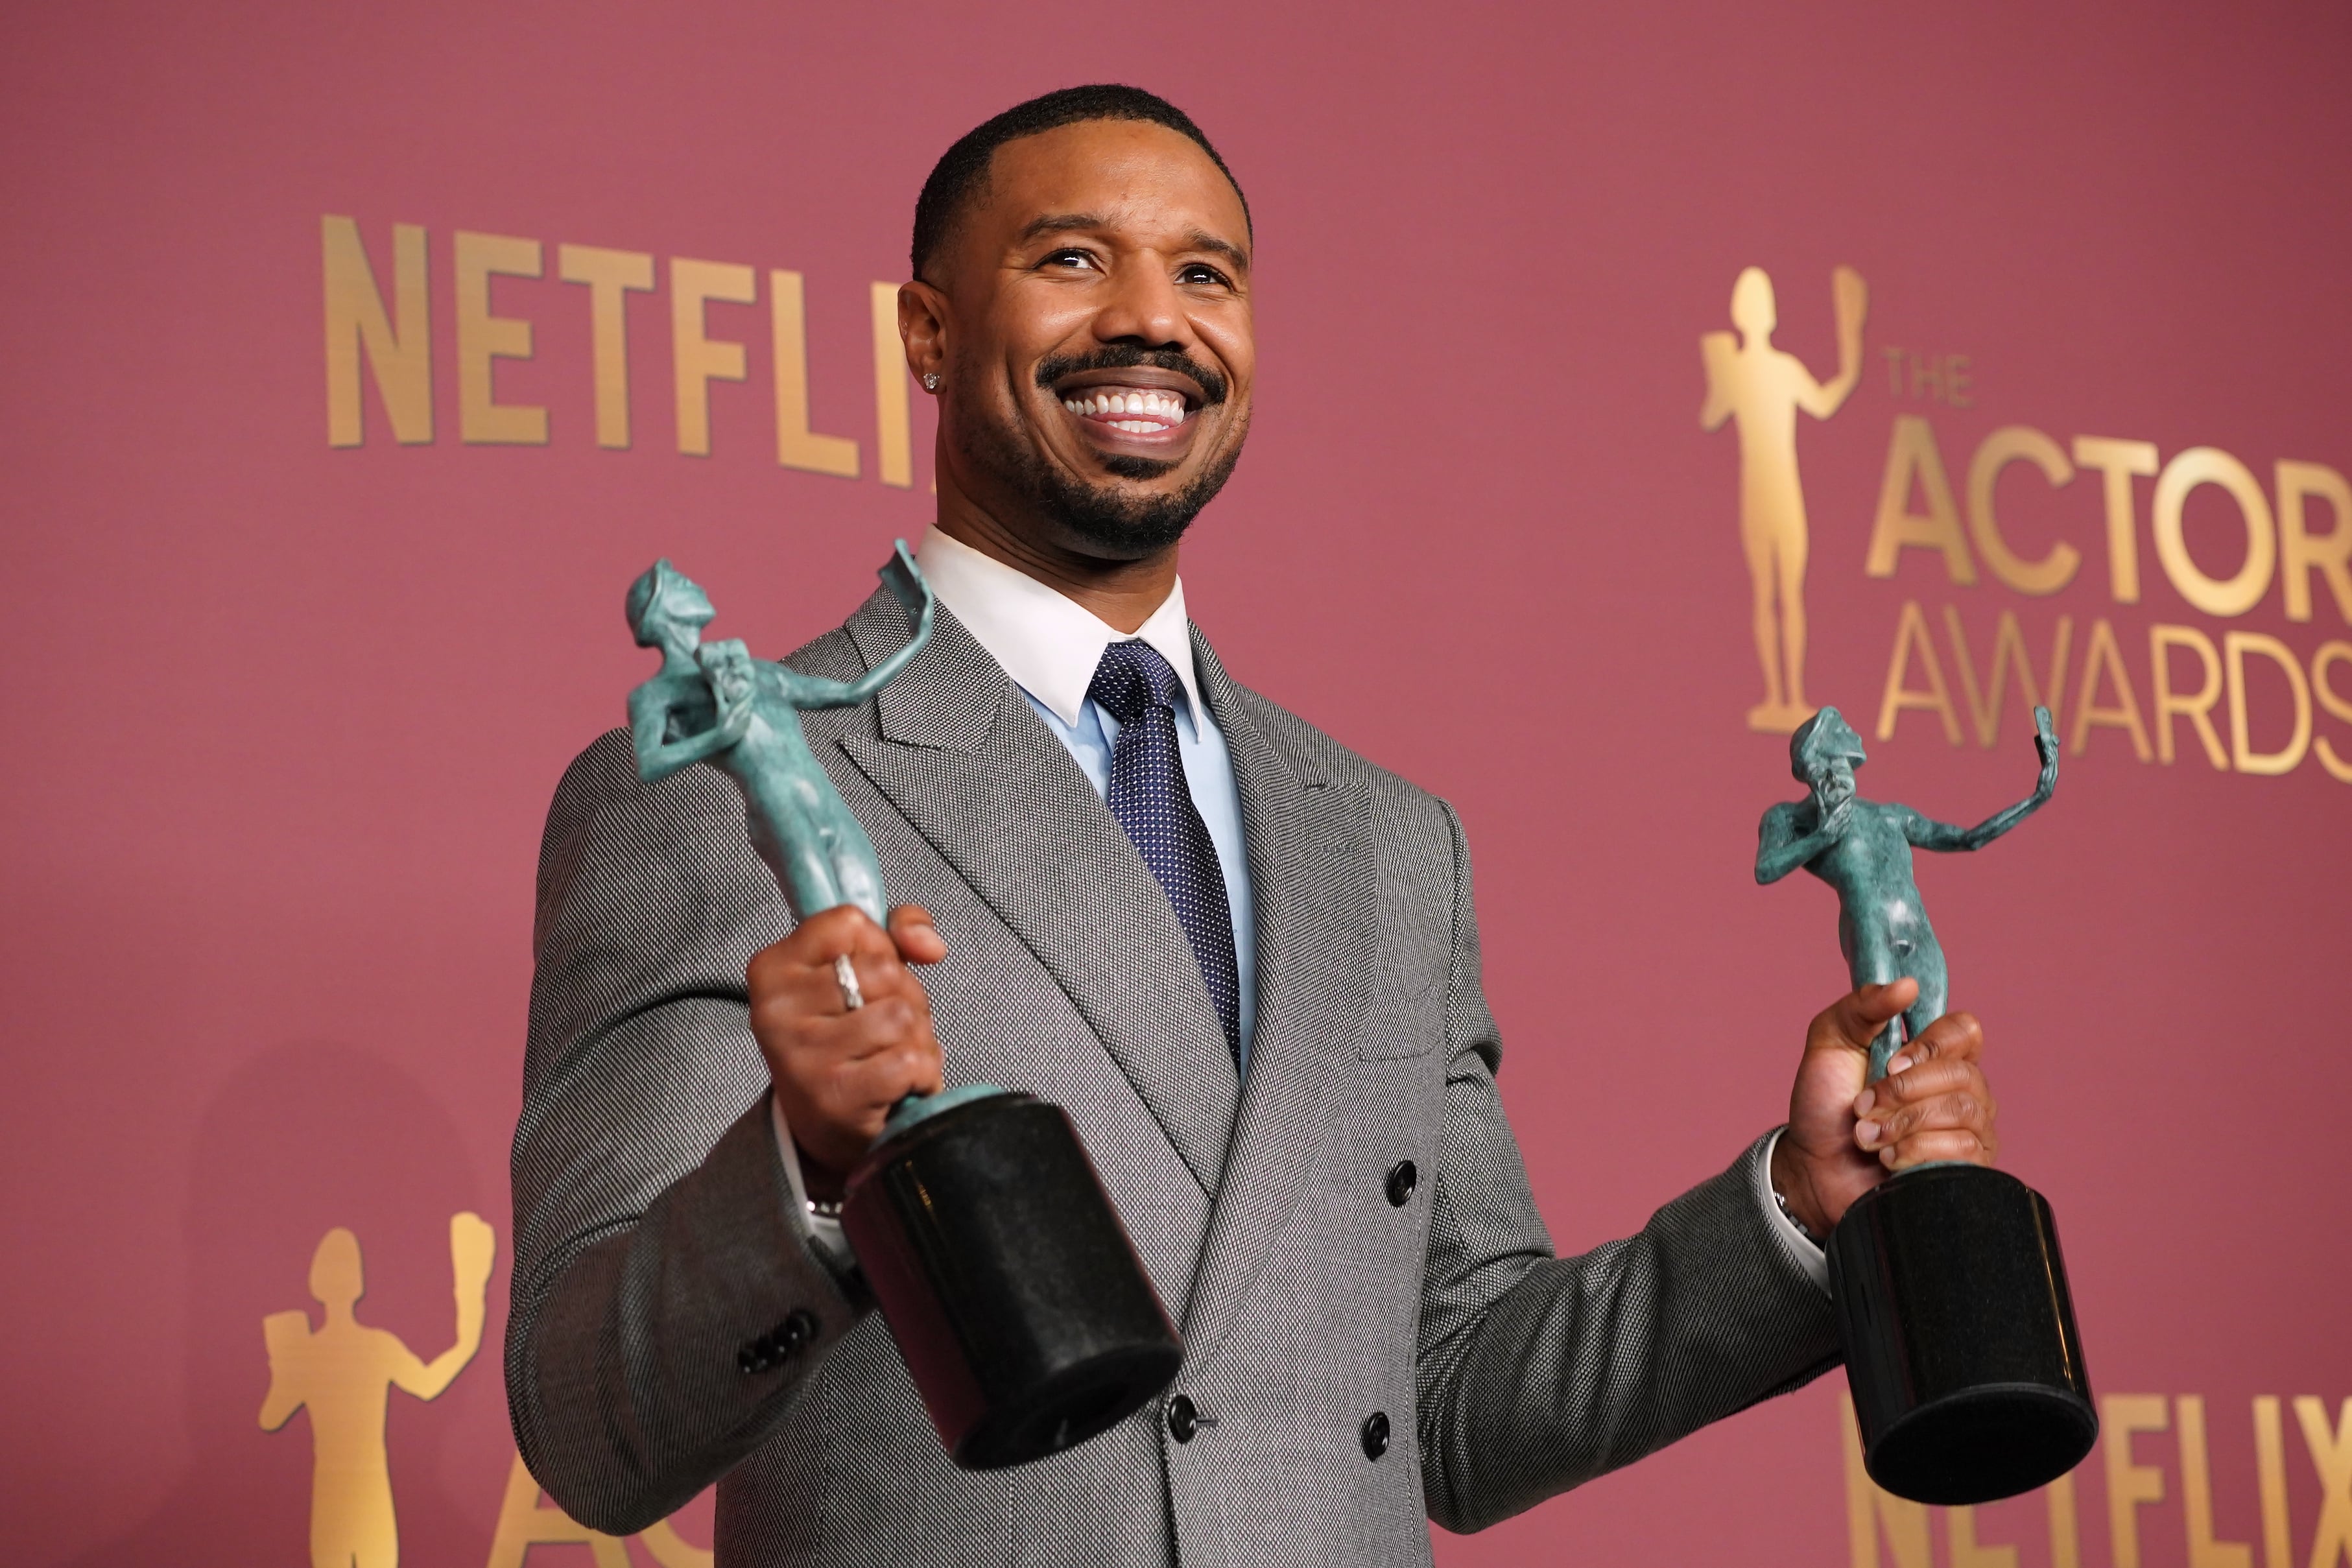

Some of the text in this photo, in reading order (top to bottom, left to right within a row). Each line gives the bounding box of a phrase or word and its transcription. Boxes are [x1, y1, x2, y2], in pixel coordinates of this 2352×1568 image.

[322, 214, 937, 496] NETFLI
[1882, 344, 1976, 410] THE
[1865, 413, 2352, 624] ACTOR
[1876, 599, 2352, 785] AWARDS
